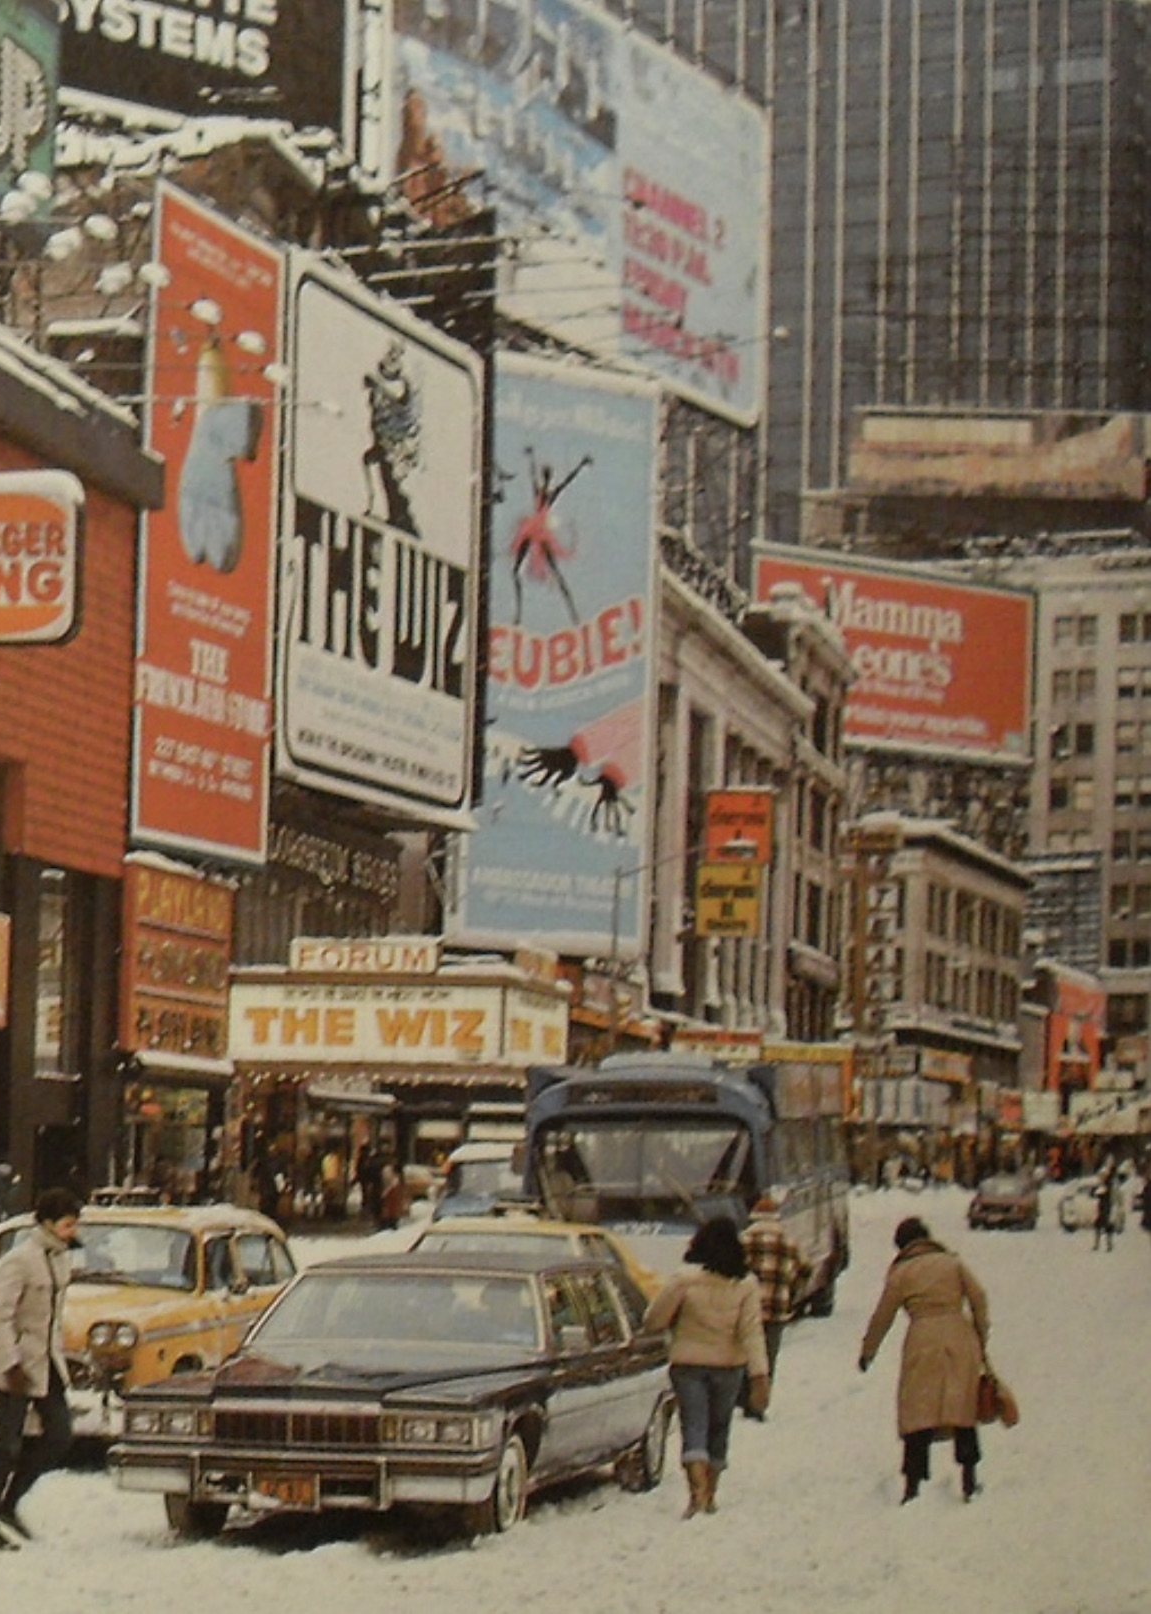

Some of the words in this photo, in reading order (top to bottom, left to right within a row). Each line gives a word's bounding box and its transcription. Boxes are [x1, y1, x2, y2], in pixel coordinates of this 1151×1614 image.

[487, 595, 644, 692] EUBIE!
[851, 642, 952, 690] eone's
[298, 945, 431, 973] FORUM
[245, 1005, 357, 1048] THE
[374, 1006, 487, 1051] WIZ
